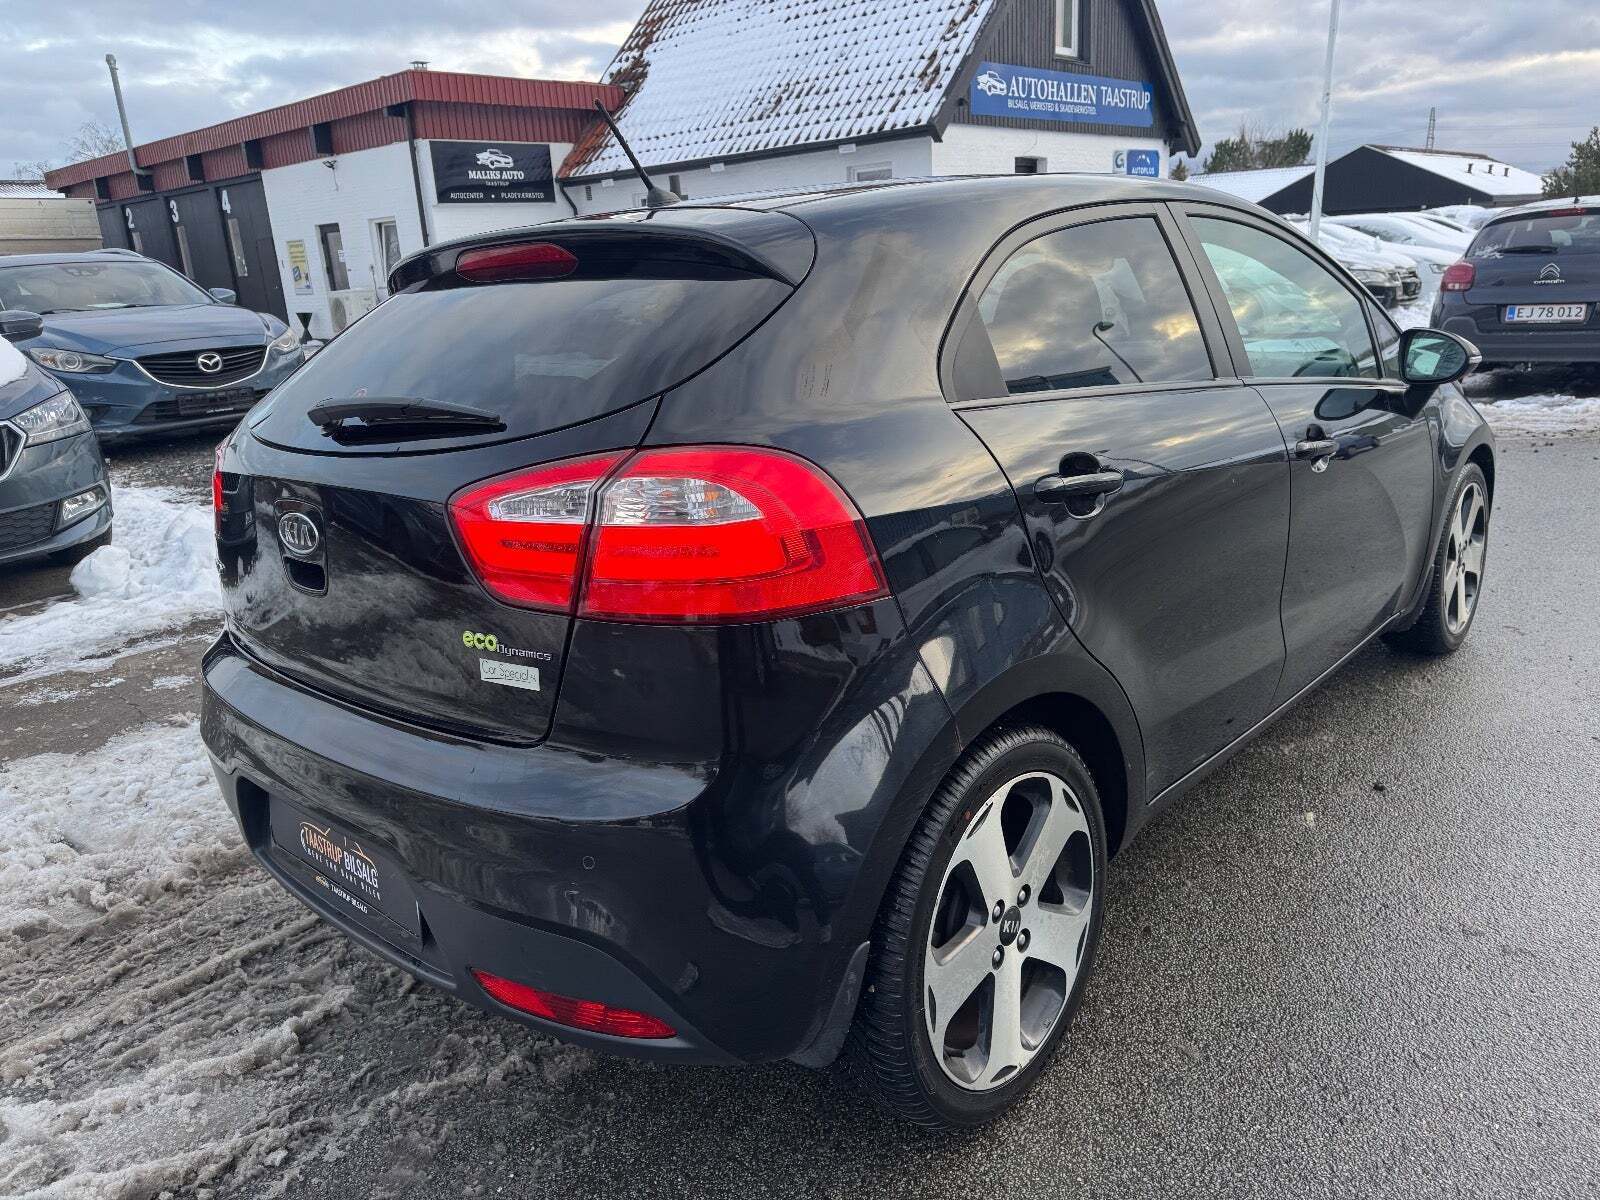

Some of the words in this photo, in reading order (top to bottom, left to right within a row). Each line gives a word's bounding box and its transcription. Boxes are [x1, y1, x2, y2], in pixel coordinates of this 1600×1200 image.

[1008, 75, 1098, 105] AUTOHALLEN
[1100, 86, 1151, 110] TAASTRUP
[1007, 98, 1029, 111] BILSALG,
[467, 170, 501, 180] MALIKS
[501, 170, 525, 180] AUTO
[169, 199, 180, 223] 3
[221, 189, 231, 214] 4
[125, 207, 135, 229] 2
[1516, 306, 1534, 318] EJ
[1538, 306, 1554, 318] 78
[1557, 306, 1583, 318] 012
[281, 519, 313, 547] KIA
[462, 630, 498, 652] eco
[303, 826, 343, 865] TAASTRUP
[343, 850, 379, 889] BILSALG
[1003, 920, 1020, 933] KIA
